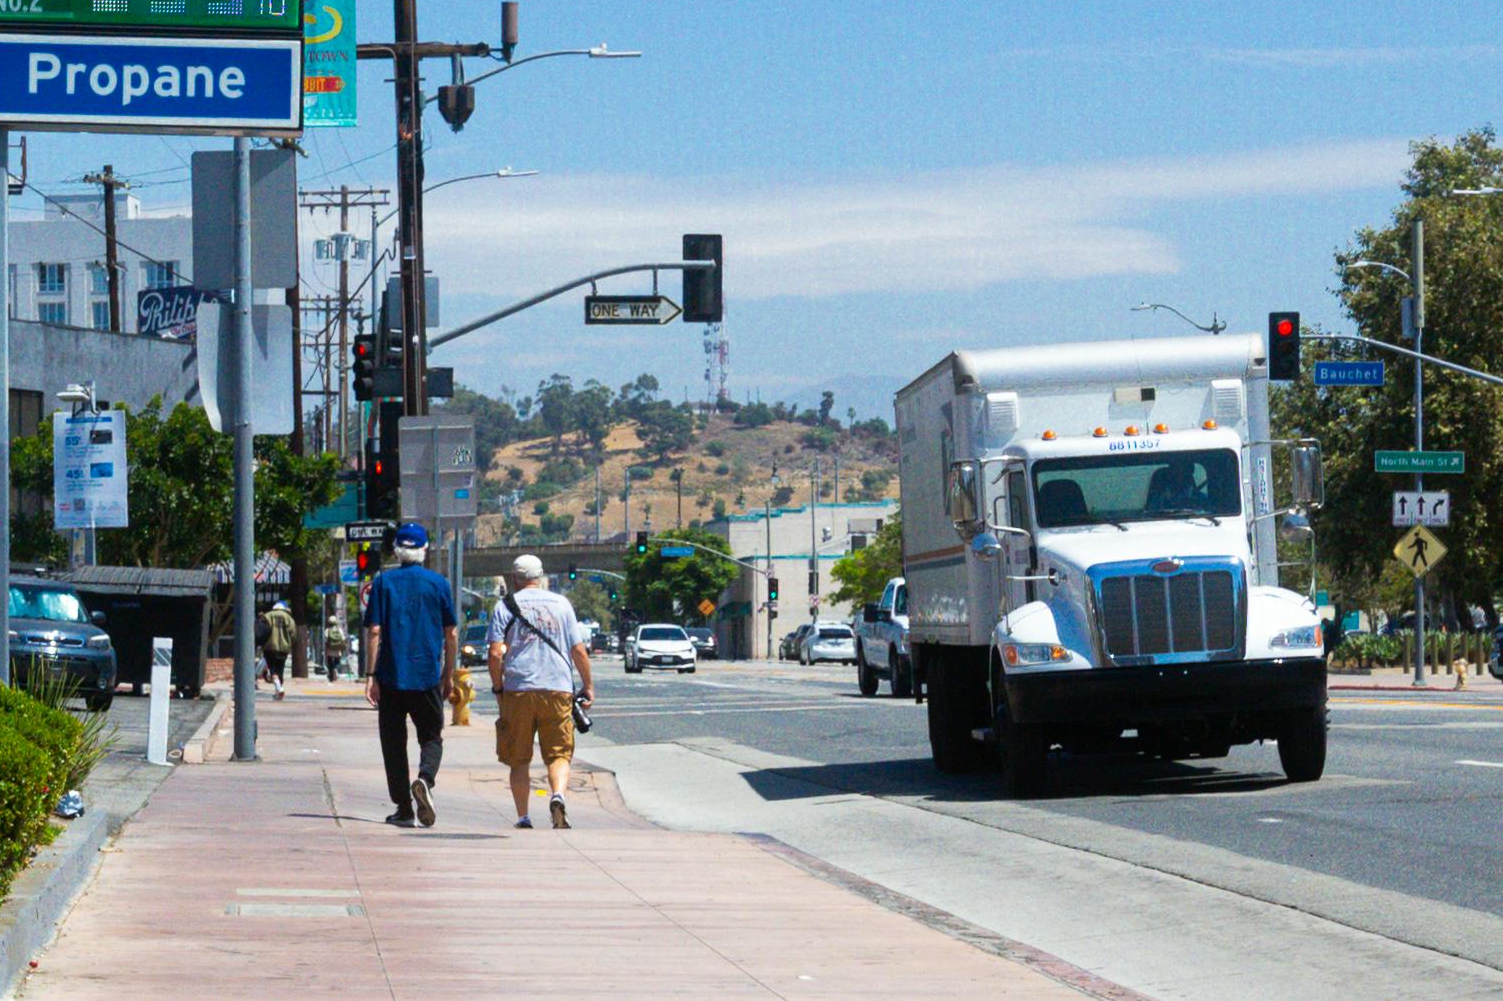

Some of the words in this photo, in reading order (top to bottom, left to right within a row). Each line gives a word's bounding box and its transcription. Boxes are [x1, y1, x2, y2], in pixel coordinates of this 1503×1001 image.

[28, 53, 246, 105] Propane
[591, 303, 620, 318] ONE
[629, 302, 659, 318] WAY
[1320, 368, 1379, 380] Bauchet
[1380, 457, 1409, 466] North
[1411, 457, 1434, 466] Main
[1437, 457, 1448, 466] St
